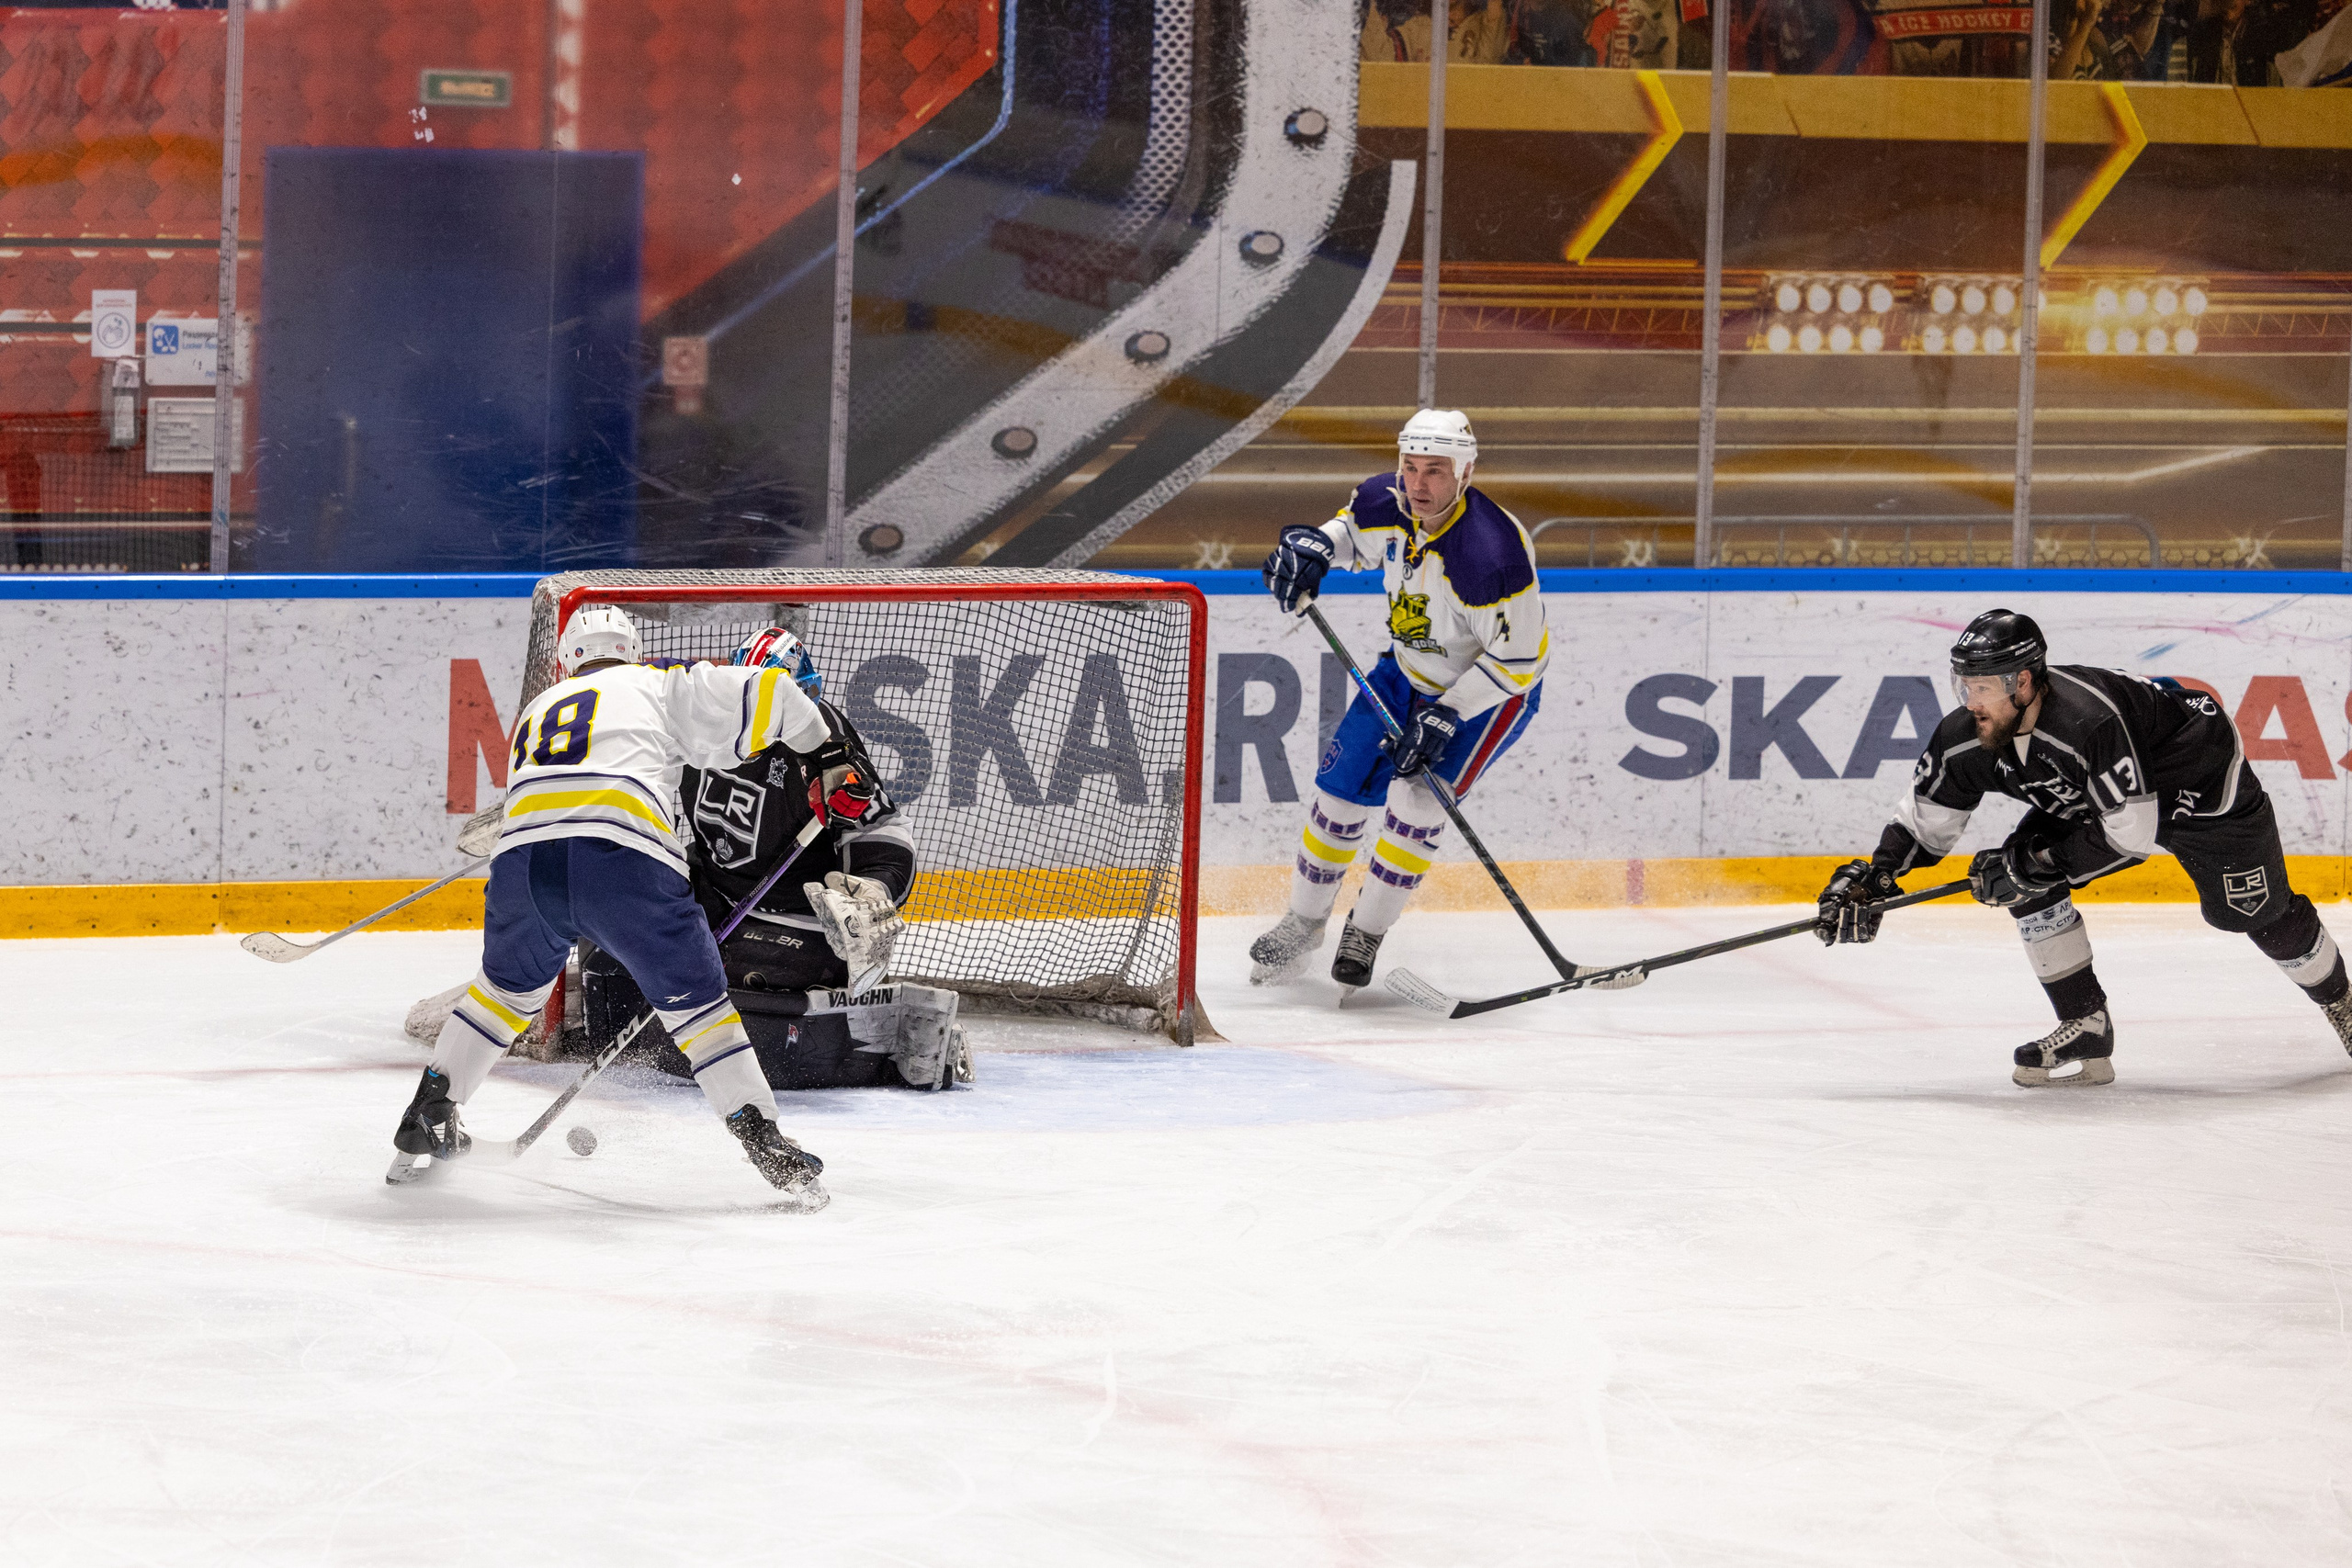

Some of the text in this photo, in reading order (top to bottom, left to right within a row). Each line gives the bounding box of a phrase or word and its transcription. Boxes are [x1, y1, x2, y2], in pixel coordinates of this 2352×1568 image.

[1937, 12, 2012, 29] HOCKEY
[1959, 631, 1975, 647] 13
[2015, 641, 2037, 656] BAUER
[821, 748, 842, 759] BAUER
[2098, 756, 2139, 805] 13
[700, 775, 757, 828] LR
[749, 875, 770, 898] TRIGGER
[2228, 874, 2263, 893] LR
[1550, 964, 1644, 997] CCM
[827, 987, 894, 1008] VAUGHN
